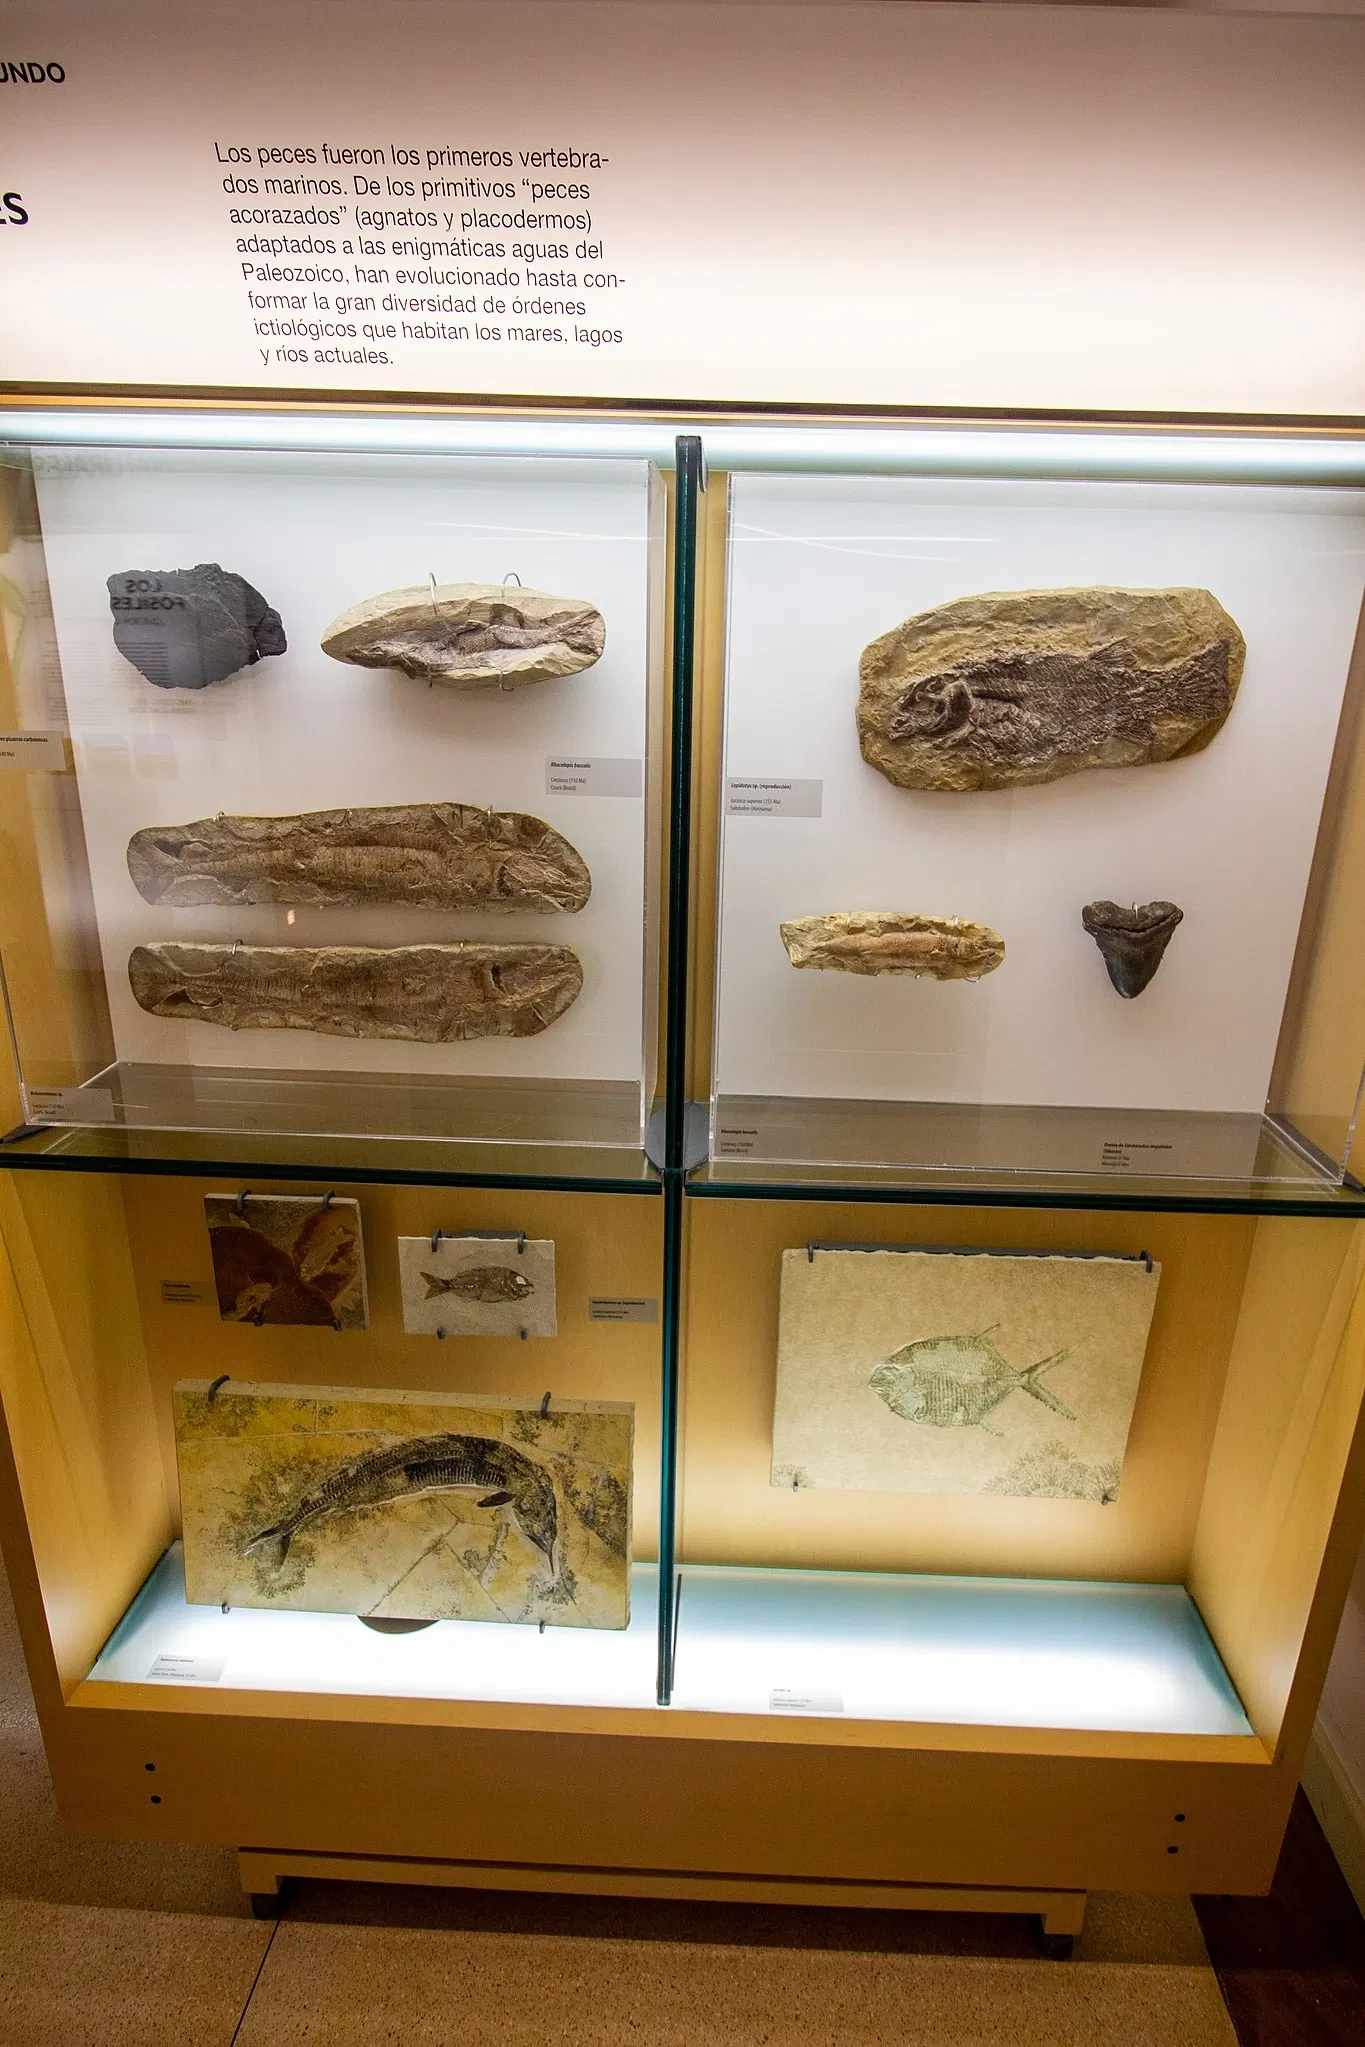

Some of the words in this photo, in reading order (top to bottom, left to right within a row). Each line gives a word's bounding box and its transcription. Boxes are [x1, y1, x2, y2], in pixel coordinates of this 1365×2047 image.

[215, 142, 251, 163] Los
[257, 148, 317, 168] peces
[322, 143, 385, 164] fueron
[391, 144, 420, 165] los
[427, 145, 513, 171] primeros
[519, 147, 609, 168] vertebra-
[223, 174, 259, 193] dos
[264, 175, 347, 195] marinos.
[353, 176, 380, 195] De
[386, 176, 415, 196] los
[421, 177, 515, 201] primitivos
[522, 178, 590, 203] “peces
[230, 205, 346, 225] acorazados”
[356, 206, 437, 231] (agnatos
[443, 213, 453, 232] y
[461, 208, 591, 234] placodermos)
[236, 234, 336, 257] adaptados
[343, 240, 354, 254] a
[359, 236, 385, 255] las
[392, 237, 505, 260] enigmáticas
[513, 244, 568, 263] aguas
[576, 240, 603, 259] del
[241, 263, 349, 285] Paleozoico,
[355, 265, 389, 283] han
[396, 266, 520, 286] evolucionado
[526, 268, 577, 287] hasta
[584, 274, 625, 288] con-
[248, 291, 307, 309] formar
[313, 292, 330, 309] la
[336, 297, 376, 315] gran
[382, 294, 476, 313] diversidad
[483, 296, 505, 313] de
[512, 296, 586, 315] órdenes
[254, 318, 357, 341] ictiológicos
[363, 325, 396, 342] que
[402, 321, 469, 339] habitan
[475, 323, 501, 340] los
[508, 328, 567, 344] mares,
[575, 325, 622, 347] lagos
[260, 349, 269, 366] y
[276, 345, 308, 362] ríos
[314, 347, 393, 364] actuales.
